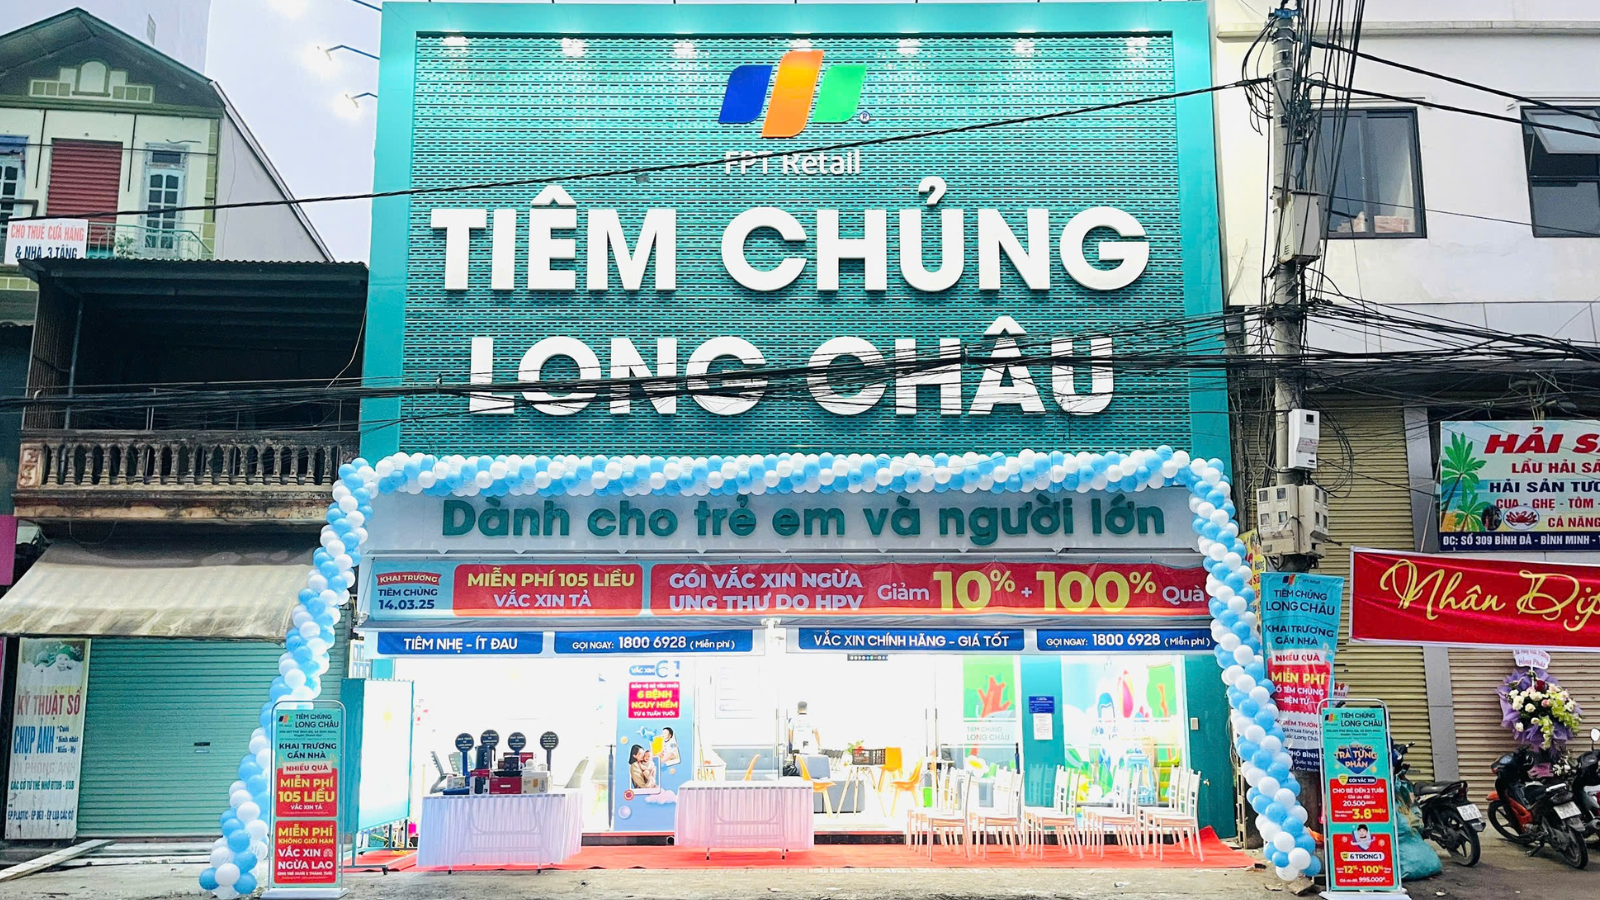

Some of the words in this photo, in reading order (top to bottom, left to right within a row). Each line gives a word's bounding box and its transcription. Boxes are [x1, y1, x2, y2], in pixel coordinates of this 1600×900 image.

[725, 151, 772, 175] FPT
[783, 150, 860, 175] Retail
[11, 224, 25, 239] CHO
[430, 185, 677, 291] TIÊM
[721, 177, 1149, 291] CHỦNG
[15, 246, 21, 258] &
[25, 244, 42, 258] NHÀ
[469, 336, 768, 416] LONG
[806, 315, 1113, 417] CHÂU
[1484, 426, 1563, 454] HẢI
[1572, 433, 1600, 454] S
[1548, 459, 1576, 473] HẢI
[1490, 478, 1520, 493] HẢI
[1526, 478, 1565, 493] SẢN
[1495, 499, 1519, 509] CUA
[1532, 499, 1555, 511] GHẸ
[1568, 496, 1594, 509] TÔM
[442, 497, 570, 537] Dành
[587, 500, 678, 537] cho
[694, 494, 756, 537] trẻ
[772, 506, 845, 537] em
[863, 495, 920, 537] và
[939, 493, 1073, 547] người
[1091, 493, 1165, 536] lớn
[1461, 532, 1474, 545] SỐ
[1475, 536, 1493, 545] 309
[1494, 534, 1517, 545] BÌNH
[1519, 534, 1532, 545] ĐÀ
[1540, 533, 1563, 545] BÌNH
[1565, 535, 1590, 545] MINH
[380, 575, 401, 583] KHAI
[402, 573, 438, 583] TRƯƠNG
[467, 566, 518, 587] MIỄN
[521, 569, 554, 587] PHÍ
[558, 572, 588, 587] 105
[593, 568, 635, 588] LIỀU
[669, 569, 706, 588] GÓI
[714, 567, 756, 588] VẮC
[761, 573, 796, 588] XIN
[802, 570, 863, 588] NGỪA
[378, 587, 401, 597] TIÊM
[403, 586, 438, 597] CHỦNG
[877, 583, 930, 601] Giảm
[933, 570, 1015, 611] 10%
[1021, 587, 1032, 598] +
[1036, 570, 1157, 612] 100%
[1162, 584, 1204, 604] Quà
[1274, 588, 1293, 597] TIÊM
[1295, 589, 1327, 601] CHỦNG
[1379, 559, 1506, 620] Nhân
[379, 599, 435, 610] 14.03.25
[494, 589, 530, 608] VẮC
[532, 594, 569, 608] XIN
[571, 590, 592, 608] TẢ
[669, 595, 718, 612] UNG
[723, 592, 771, 611] THƯ
[775, 594, 809, 611] DO
[815, 594, 864, 611] HPV
[1266, 601, 1298, 611] LONG
[1300, 602, 1335, 615] CHÂU
[813, 630, 842, 646] VẮC
[844, 635, 865, 646] XIN
[867, 632, 907, 646] CHÍNH
[909, 632, 946, 647] HÃNG
[958, 633, 981, 647] GIÁ
[983, 631, 1009, 646] TỐT
[1265, 625, 1289, 633] KHAI
[1291, 625, 1334, 638] TRƯƠNG
[403, 635, 435, 650] TIÊM
[436, 638, 463, 653] NHẸ
[476, 635, 489, 649] ÍT
[490, 638, 518, 649] ĐAU
[572, 642, 589, 651] GỌI
[618, 636, 650, 649] 1800
[653, 636, 686, 649] 6928
[1046, 639, 1062, 649] GỌI
[1092, 633, 1124, 646] 1800
[1127, 633, 1160, 646] 6928
[1297, 636, 1318, 646] NHÀ
[1301, 652, 1320, 662] QUÀ
[1303, 672, 1326, 685] PHÍ
[66, 687, 82, 715] SỐ
[645, 689, 672, 700] BỆNH
[631, 701, 655, 709] NGUY
[318, 720, 339, 728] CHÂU
[1363, 719, 1382, 727] CHÂU
[14, 725, 36, 760] CHỤP
[301, 742, 337, 750] TRƯƠNG
[307, 751, 326, 759] NHÀ
[311, 763, 328, 771] QUÀ
[280, 775, 310, 788] MIỄN
[313, 776, 334, 788] PHÍ
[278, 791, 301, 803] 105
[1352, 808, 1372, 819] 3.8
[278, 823, 309, 837] MIỄN
[312, 825, 333, 837] PHÍ
[278, 845, 301, 857] VẮC
[303, 849, 321, 857] XIN
[278, 859, 309, 869] NGỪA
[311, 861, 334, 869] LAO
